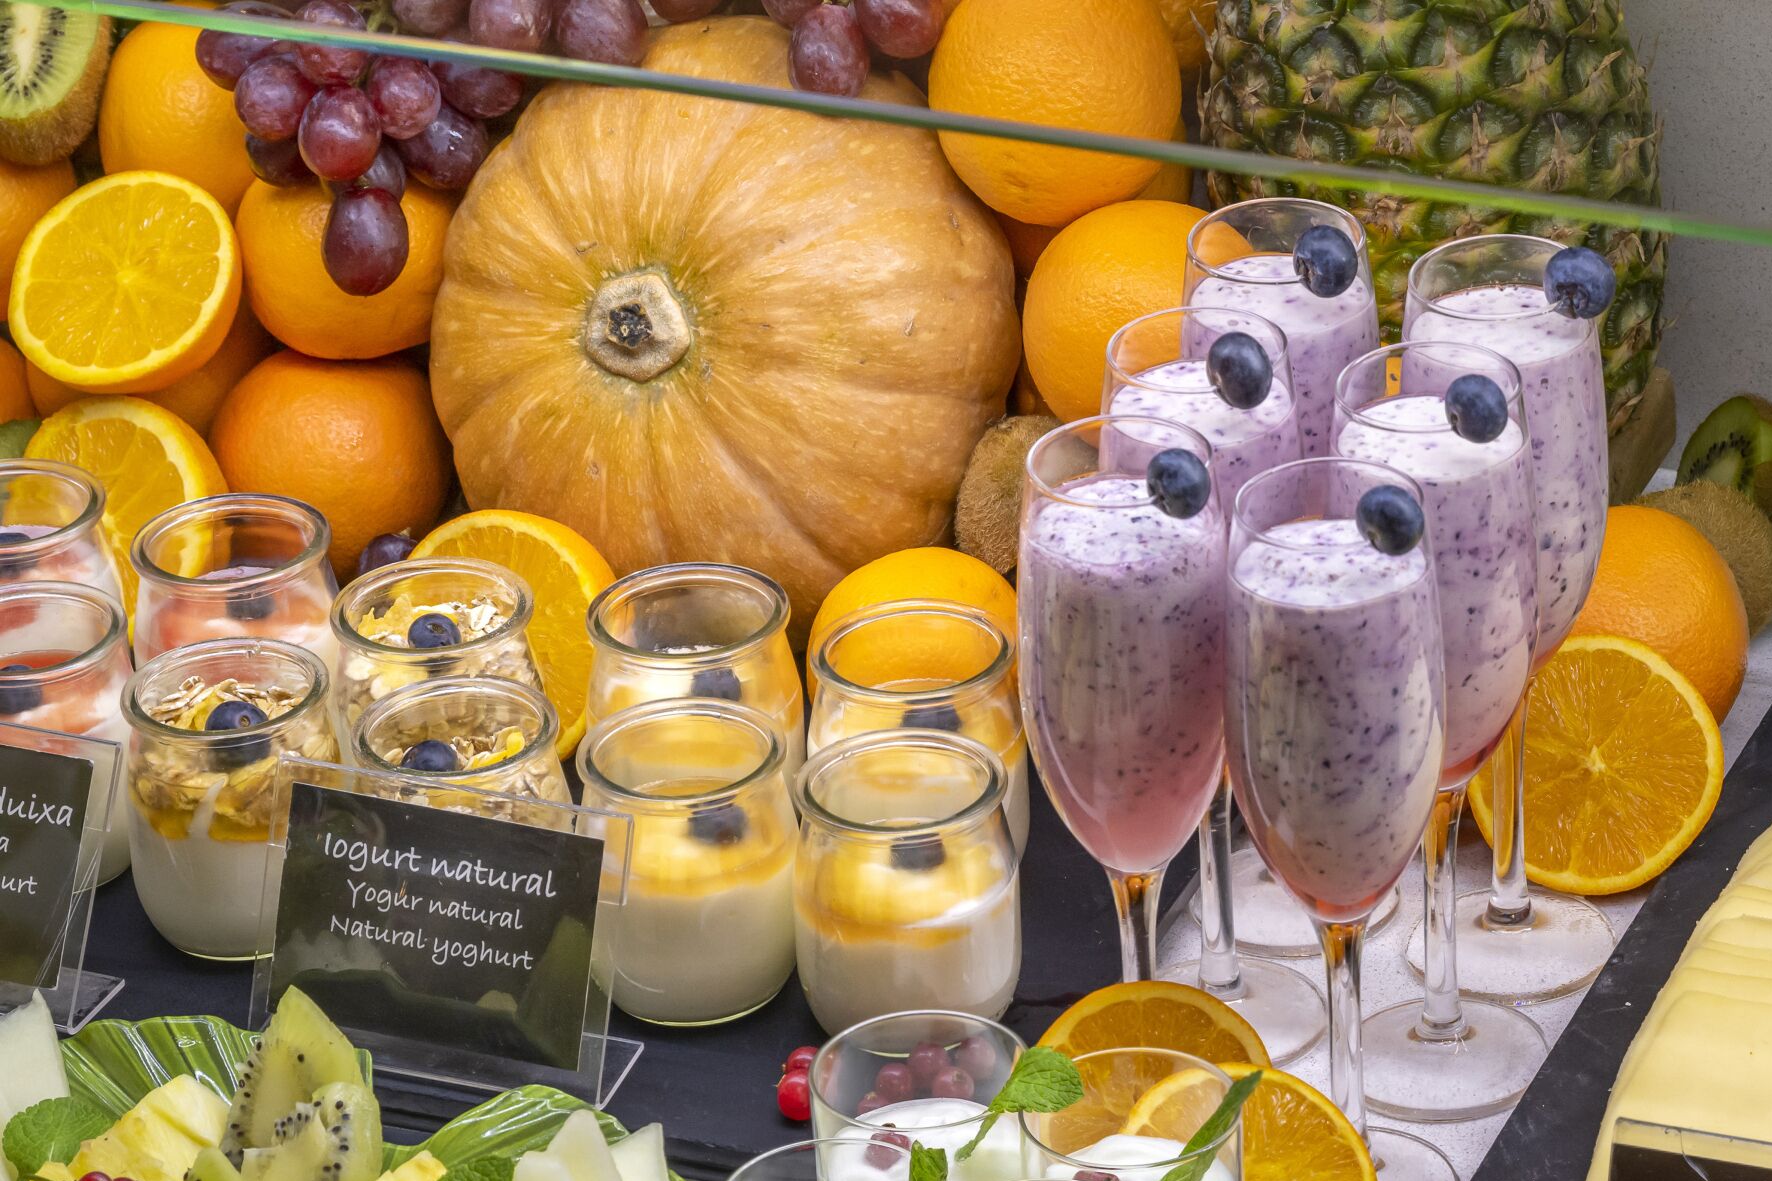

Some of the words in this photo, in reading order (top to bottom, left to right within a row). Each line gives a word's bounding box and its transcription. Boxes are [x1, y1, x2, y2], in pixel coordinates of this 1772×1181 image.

[324, 831, 421, 872] Iogurt
[430, 857, 557, 899] natural
[347, 879, 423, 912] Yogur
[429, 900, 522, 929] natural
[331, 915, 425, 948] Natural
[432, 937, 533, 969] yoghurt
